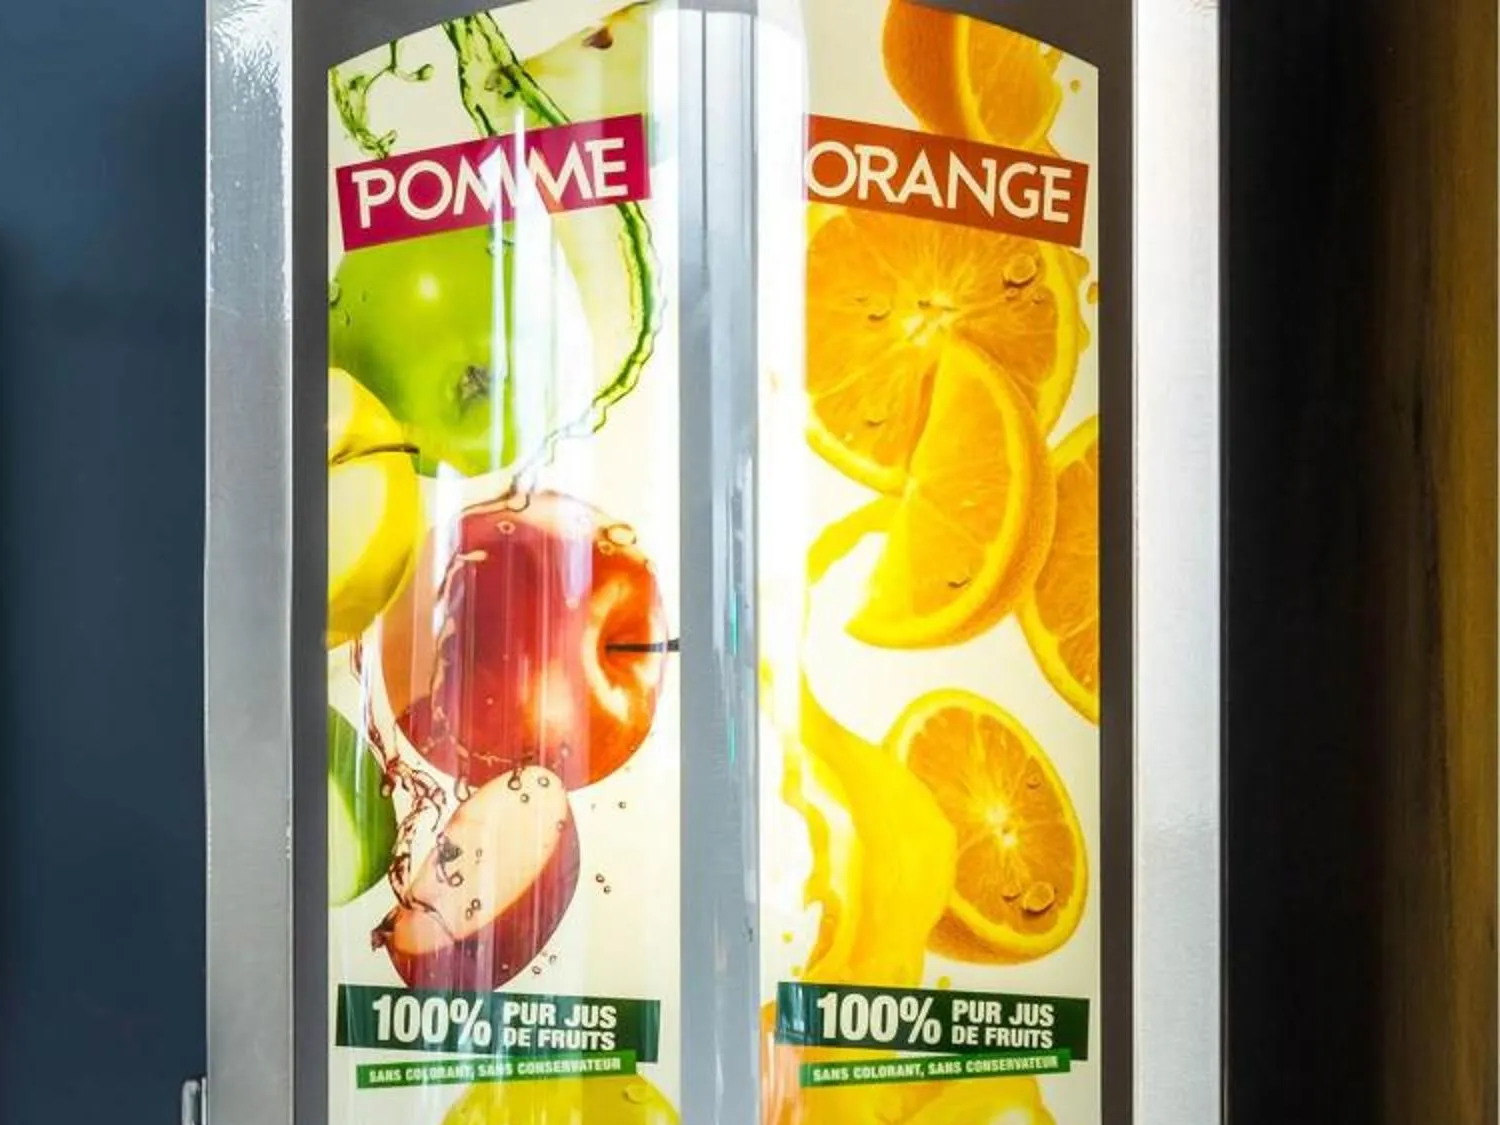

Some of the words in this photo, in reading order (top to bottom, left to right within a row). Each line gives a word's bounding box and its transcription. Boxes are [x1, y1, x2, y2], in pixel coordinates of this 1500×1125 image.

[352, 137, 629, 229] POMME
[803, 140, 1072, 223] ORANGE
[372, 994, 493, 1048] 100%
[502, 1001, 558, 1027] PUR
[564, 1005, 618, 1030] JUS
[817, 991, 943, 1046] 100%
[951, 999, 1003, 1026] PUR
[1008, 1002, 1056, 1028] JUS
[502, 1027, 535, 1048] DE
[538, 1029, 616, 1051] FRUITS
[951, 1026, 981, 1047] DE
[985, 1027, 1054, 1050] FRUITS
[368, 1068, 402, 1084] SANS
[478, 1062, 514, 1078] SANS
[516, 1056, 622, 1076] CONSERVATEUR
[812, 1066, 850, 1082] SANS
[927, 1060, 963, 1076] SANS
[965, 1054, 1060, 1075] CONSERVATEUR
